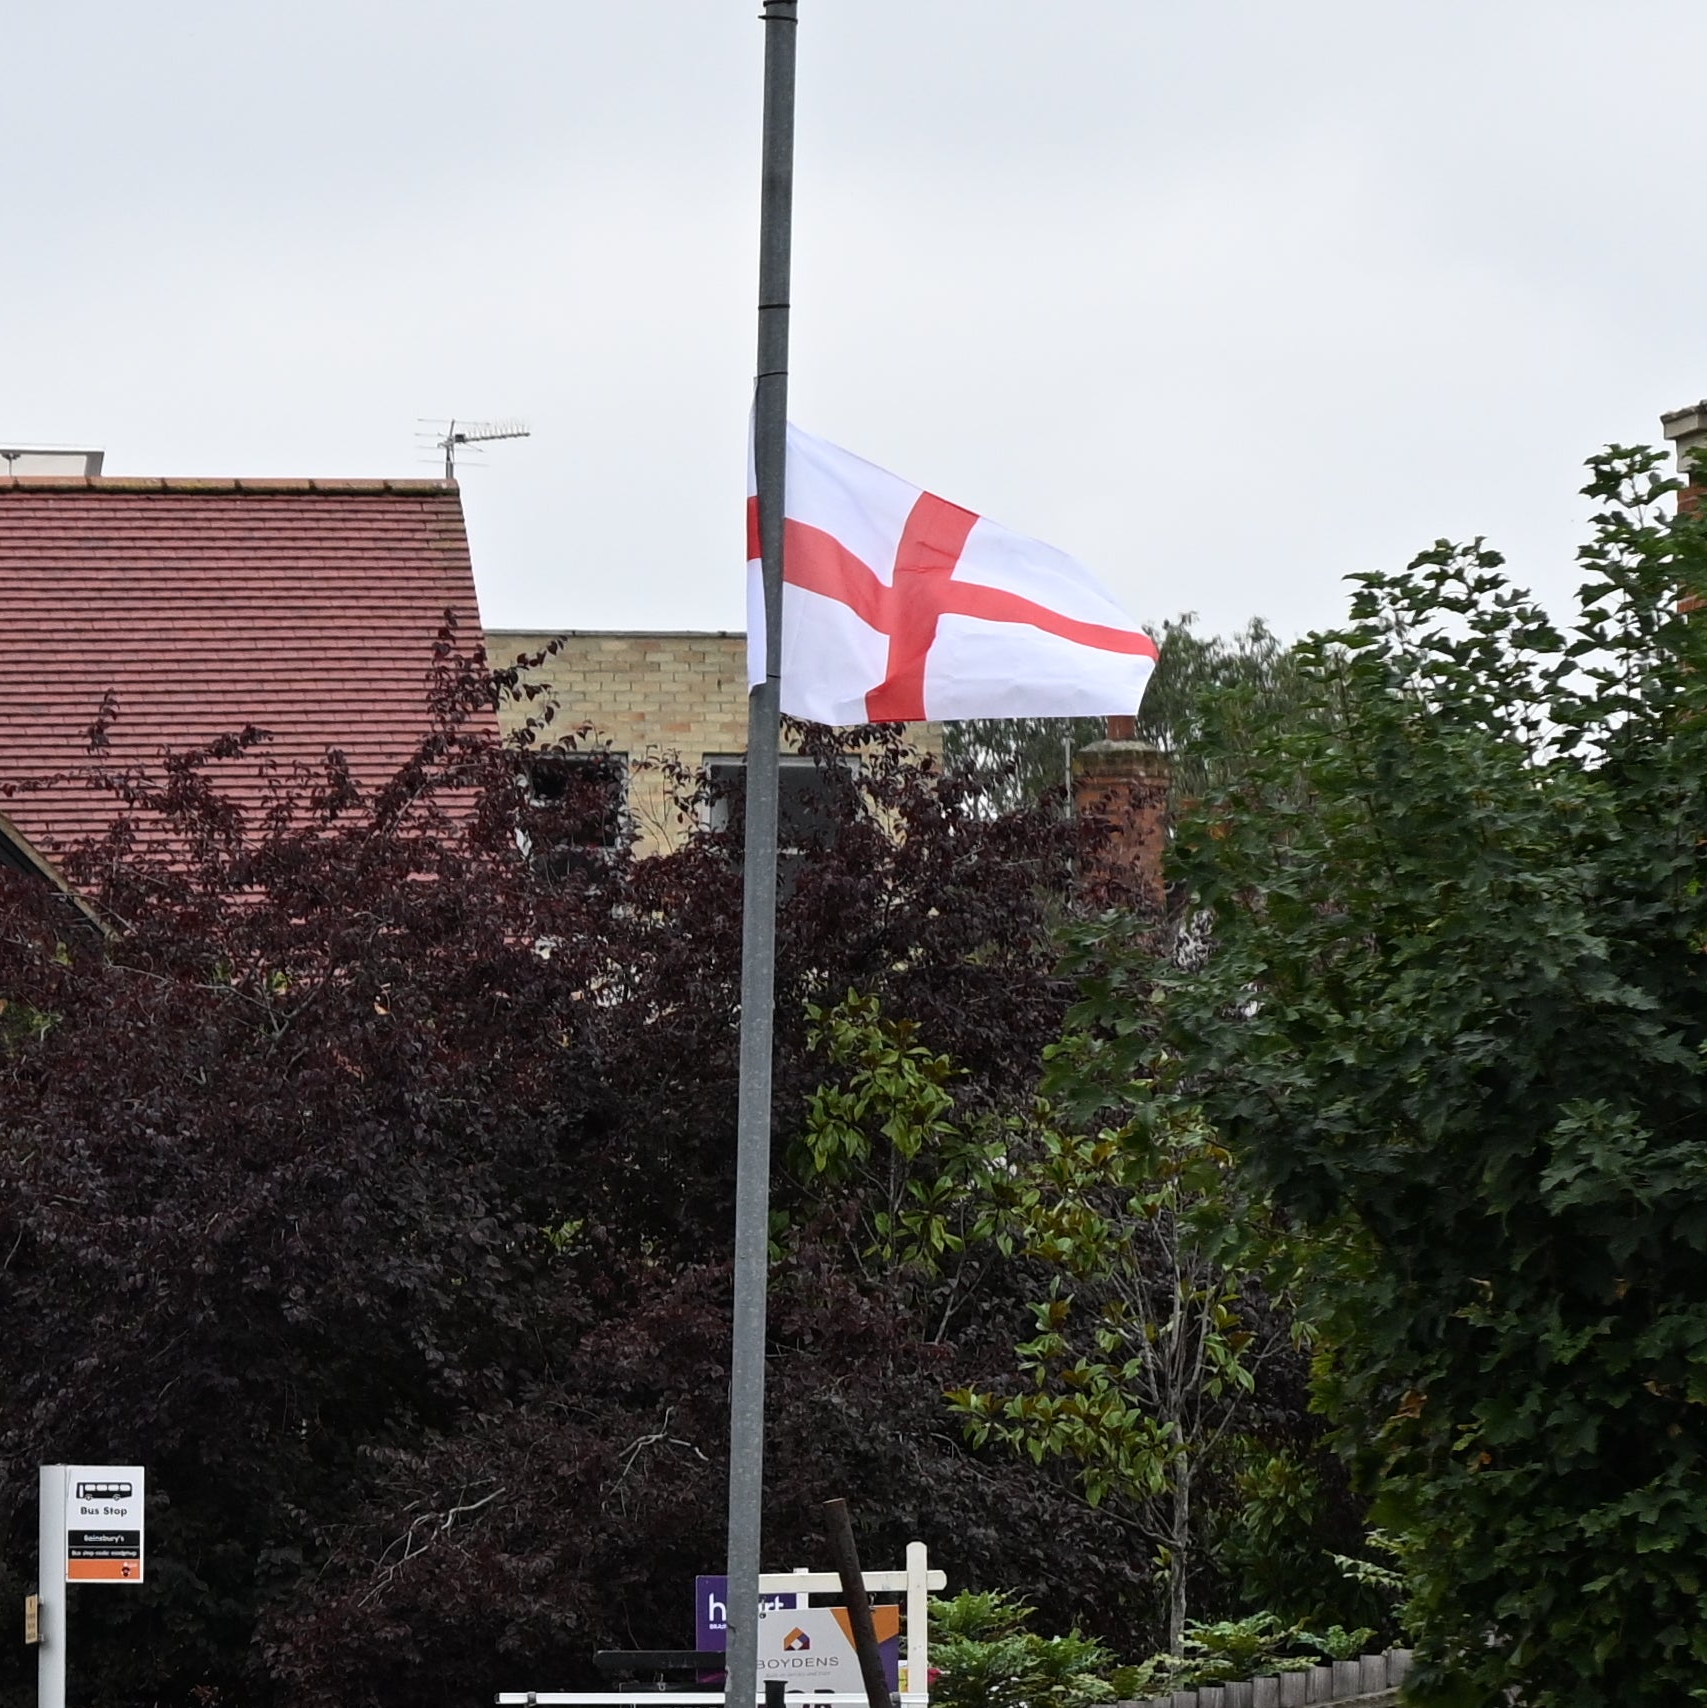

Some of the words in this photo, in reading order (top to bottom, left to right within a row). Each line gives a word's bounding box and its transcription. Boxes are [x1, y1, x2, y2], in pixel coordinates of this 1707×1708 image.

[80, 1507, 99, 1515] Bus
[104, 1506, 127, 1517] Stop
[757, 1656, 840, 1669] BOYDENS
